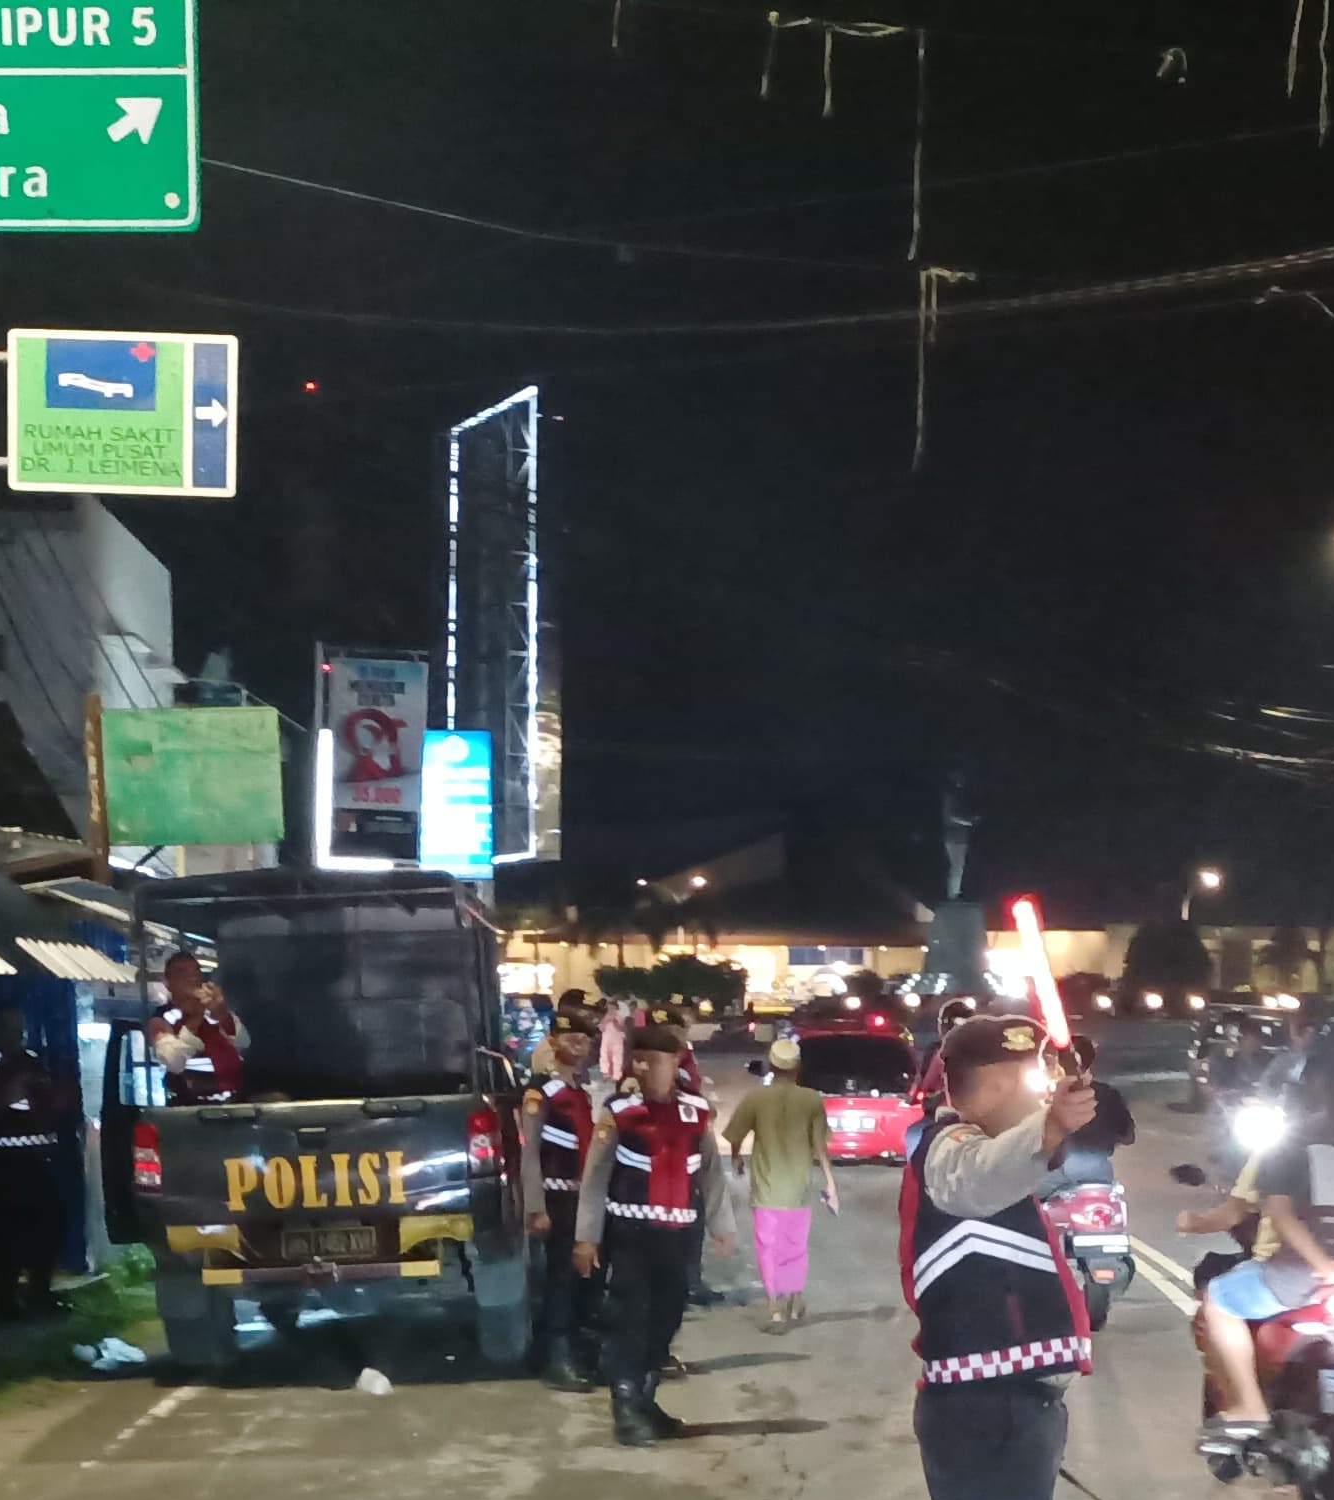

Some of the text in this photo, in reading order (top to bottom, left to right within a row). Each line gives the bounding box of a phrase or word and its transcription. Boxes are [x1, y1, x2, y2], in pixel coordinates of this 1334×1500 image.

[132, 7, 157, 47] 5
[24, 423, 179, 444] RUMAH SAKIT
[33, 442, 166, 460] UMUM PUSAT
[88, 459, 182, 478] LEIMENA
[223, 1150, 407, 1212] POLISI
